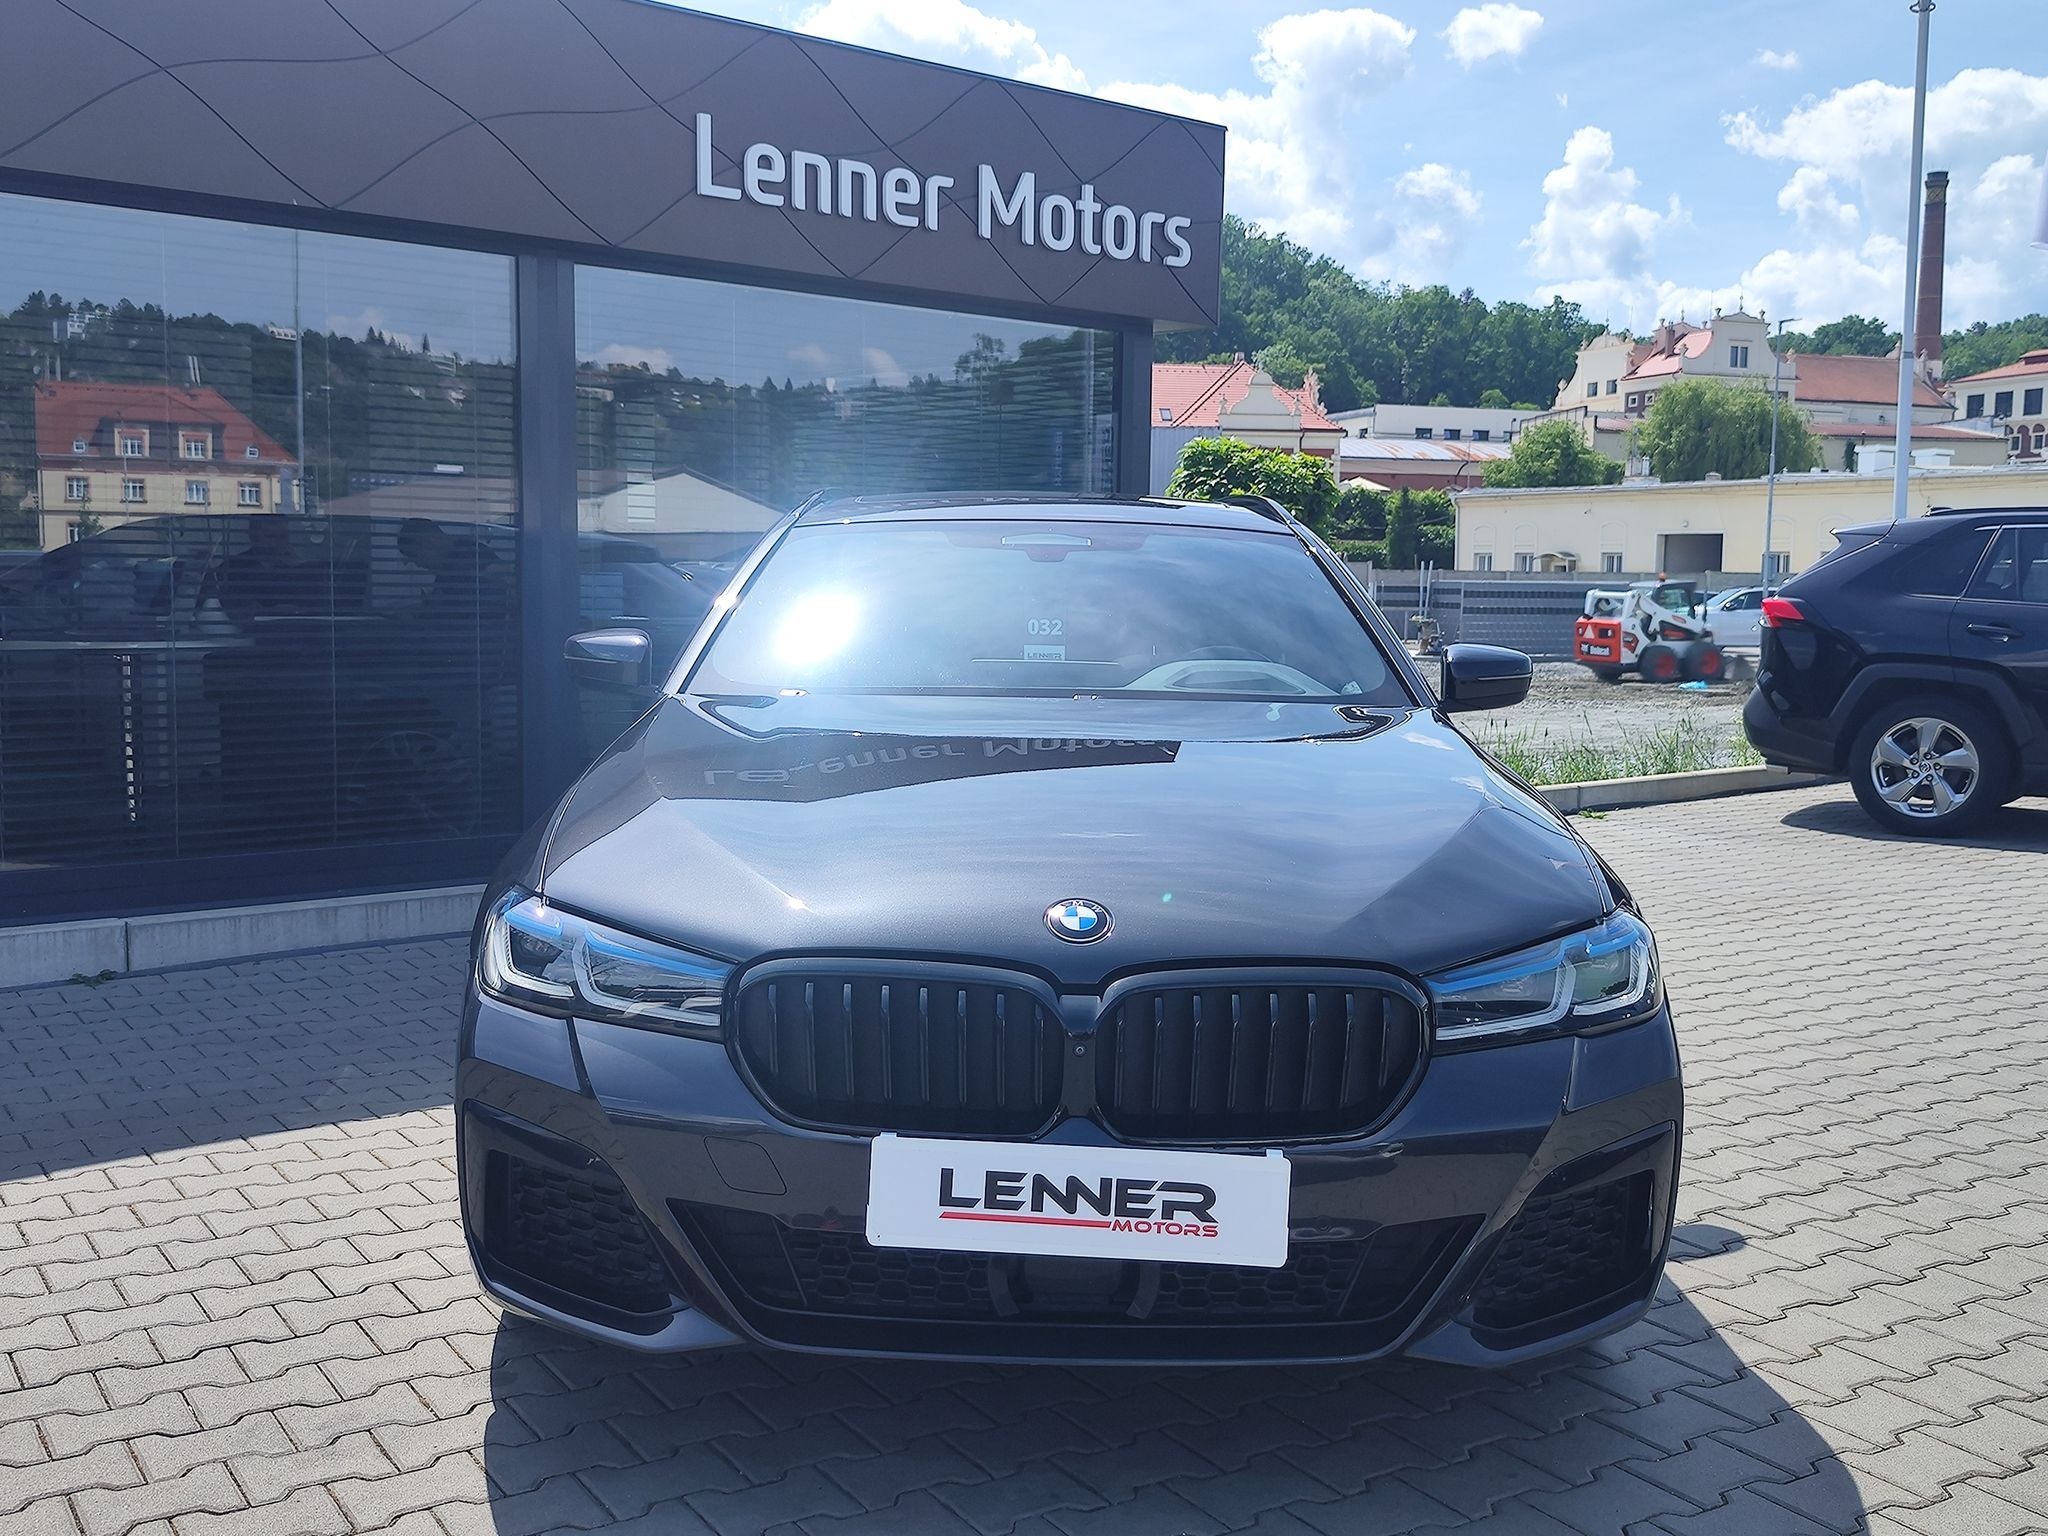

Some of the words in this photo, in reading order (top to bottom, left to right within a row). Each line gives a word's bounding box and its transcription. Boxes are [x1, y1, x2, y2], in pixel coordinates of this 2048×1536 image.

[695, 113, 955, 232] Lenner
[977, 164, 1193, 268] Motors
[1027, 618, 1063, 636] 032
[938, 1167, 1219, 1223] LENNER
[1111, 1219, 1219, 1238] MOTORS
